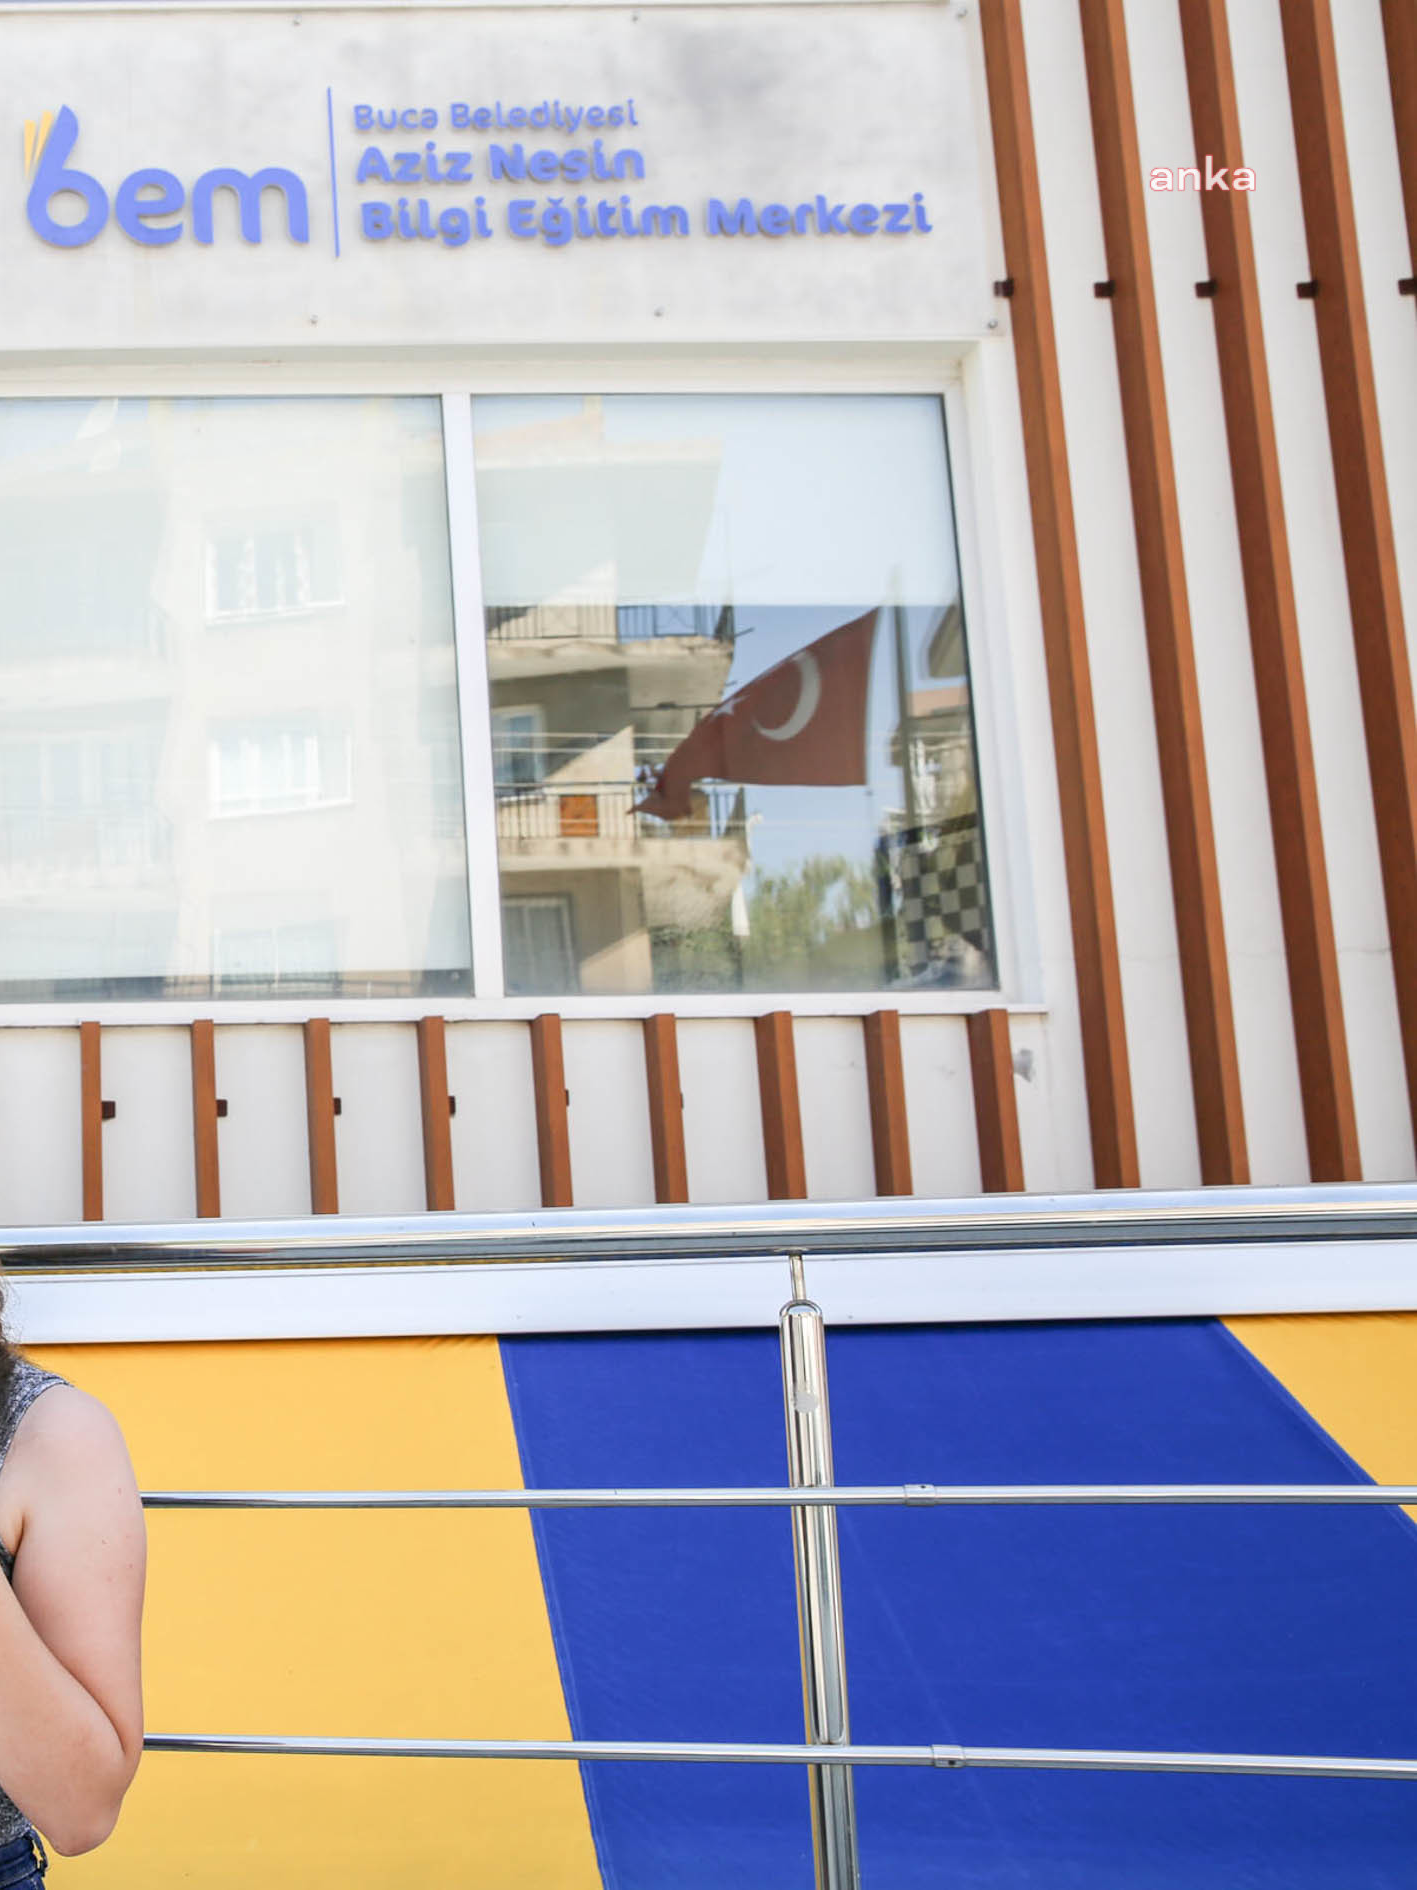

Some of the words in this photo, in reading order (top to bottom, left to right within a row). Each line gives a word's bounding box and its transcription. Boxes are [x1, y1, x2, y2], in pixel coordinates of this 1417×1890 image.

[353, 102, 439, 131] Buca
[450, 98, 638, 134] Belediyesi
[26, 103, 310, 248] bem
[356, 141, 474, 183] Aziz
[488, 138, 645, 181] Nesin
[360, 196, 493, 246] Bilgi
[507, 195, 690, 246] Eğitim
[708, 192, 933, 236] Merkezi
